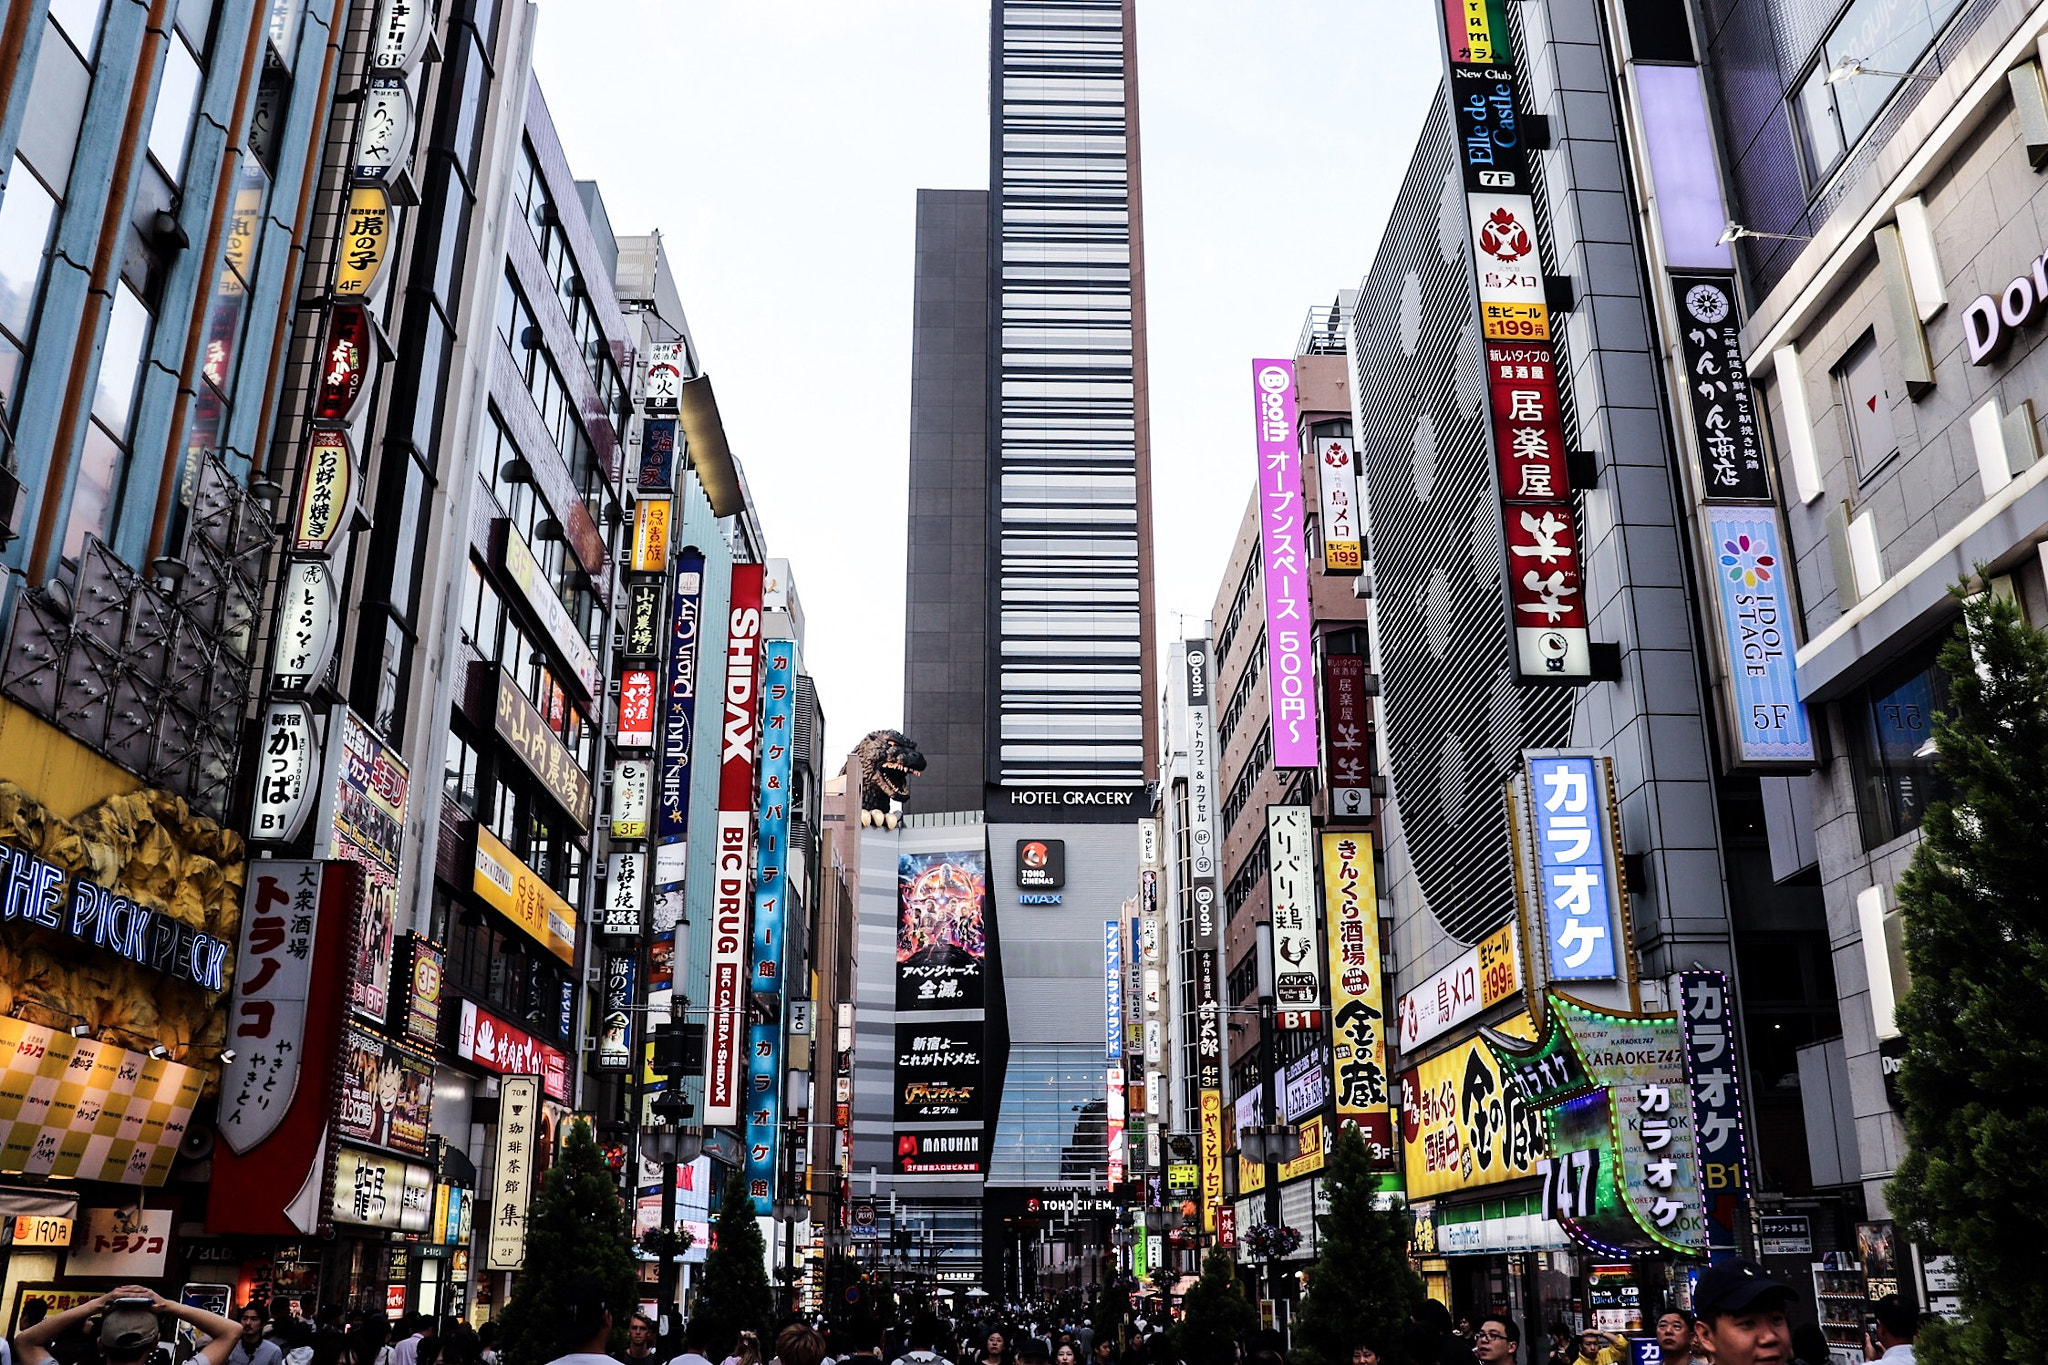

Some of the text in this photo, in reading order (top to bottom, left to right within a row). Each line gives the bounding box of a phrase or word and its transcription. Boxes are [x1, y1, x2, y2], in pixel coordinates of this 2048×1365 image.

[388, 0, 410, 43] キトリ
[377, 53, 405, 66] 6F
[1456, 69, 1512, 81] New Club
[1459, 47, 1502, 60] ガラム
[1463, 94, 1494, 166] Elle de
[1490, 84, 1517, 148] Castle
[363, 167, 381, 176] 5F
[1483, 173, 1513, 185] 7F
[347, 217, 384, 270] 虎の子
[339, 281, 362, 290] 4F
[1485, 273, 1537, 289] 鳥メロ
[1488, 306, 1541, 318] 生ビール
[1490, 349, 1550, 363] 新しいタイプの
[1501, 366, 1545, 379] 居酒屋
[1259, 366, 1290, 442] Booth
[1689, 328, 1740, 486] かんかん商店
[640, 430, 673, 486] 海の家
[1509, 390, 1554, 496] 居楽屋
[308, 450, 337, 538] お好み焼き
[1332, 490, 1350, 537] 鳥メロ
[297, 541, 323, 550] 2階
[646, 509, 663, 562] 鳥貴族
[1267, 452, 1300, 620] オープンスペース
[1329, 543, 1357, 551] 生ビール
[1333, 551, 1358, 562] 199
[290, 588, 314, 670] とらそば
[632, 587, 655, 646] 山内農場
[1736, 594, 1765, 676] STAGE
[1756, 594, 1783, 662] IDOL
[636, 645, 647, 654] 5F
[281, 676, 303, 689] 1F
[722, 607, 761, 765] SHIDAX
[1187, 650, 1206, 697] Booth
[272, 713, 301, 727] 新宿
[499, 686, 513, 722] 5F
[637, 684, 652, 720] 焼肉屋
[1339, 678, 1353, 721] 居楽屋
[1753, 704, 1790, 729] 5F
[345, 718, 374, 764] 出会い
[511, 700, 579, 812] 山内農場
[627, 734, 643, 745] 4F
[664, 715, 686, 807] SHINJUKU
[261, 727, 298, 805] かっぱ
[350, 758, 370, 788] カフェ
[371, 755, 406, 808] キラリ
[1193, 711, 1207, 823] ネットカフェ & カプセル
[758, 655, 788, 978] カラオケ&パーティー館
[1011, 791, 1133, 805] HOTEL GRACERY
[260, 814, 286, 830] B1
[620, 823, 639, 835] 3F
[614, 855, 636, 909] お好み焼
[657, 860, 685, 868] Penelope
[1021, 870, 1046, 878] TOHO
[1021, 877, 1054, 885] CINEMAS
[1272, 811, 1303, 930] バリバリ鶏
[1543, 765, 1605, 969] カラオケ
[515, 875, 545, 932] 鳥貴族
[716, 827, 745, 954] BIC DRUG
[1019, 894, 1062, 904] IMAX
[1196, 886, 1213, 936] Booth
[1336, 840, 1366, 966] きんくら酒場
[286, 866, 318, 961] 大衆酒場
[606, 911, 639, 924] 大阪家
[72, 880, 153, 964] PICK
[152, 914, 229, 993] PECK
[237, 876, 290, 1039] トラノコ
[1480, 932, 1510, 970] 生ビール
[418, 963, 437, 994] 3F
[609, 958, 629, 1008] 海の家
[721, 967, 733, 990] BIC
[902, 964, 980, 978] アベンジャーズ、
[917, 979, 963, 999] 全滅。
[1107, 927, 1120, 1054] 747 カラオケランド
[1203, 952, 1212, 999] 手作り居酒屋
[1344, 969, 1362, 979] KIN
[1344, 983, 1369, 993] KURA
[1350, 977, 1361, 985] no
[1437, 966, 1475, 1026] 鳥メロ
[459, 1022, 473, 1050] 4F
[1198, 1000, 1219, 1057] 甘太郎
[1285, 1011, 1312, 1029] B1
[17, 1041, 45, 1059] トラノコ
[899, 1052, 980, 1066] これがトドメだ。
[1202, 1066, 1218, 1075] 4F
[1335, 1000, 1387, 1108] 金の蔵
[1688, 981, 1737, 1153] カラオケ
[228, 1053, 266, 1125] やきとん
[257, 1039, 293, 1111] やきとり
[1202, 1077, 1219, 1087] 3F
[1402, 1078, 1413, 1113] 2F
[1514, 1053, 1569, 1098] カラオケ
[750, 1040, 773, 1198] カラオケ館
[919, 1106, 958, 1115] 4.27(金)
[1422, 1081, 1456, 1126] きんくら
[504, 1122, 525, 1195] 珈琲茶館
[923, 1137, 979, 1152] MARUHAN
[1324, 1131, 1333, 1154] 2F
[1424, 1130, 1446, 1173] 酒場
[1640, 1084, 1684, 1227] カラオケ
[1204, 1113, 1221, 1227] やきとりセンター
[1536, 1150, 1591, 1221] 747
[1706, 1163, 1741, 1188] B1
[499, 1203, 522, 1228] 集
[1221, 1218, 1234, 1243] 焼肉
[94, 1235, 164, 1254] トラノコ
[501, 1248, 514, 1257] 2F
